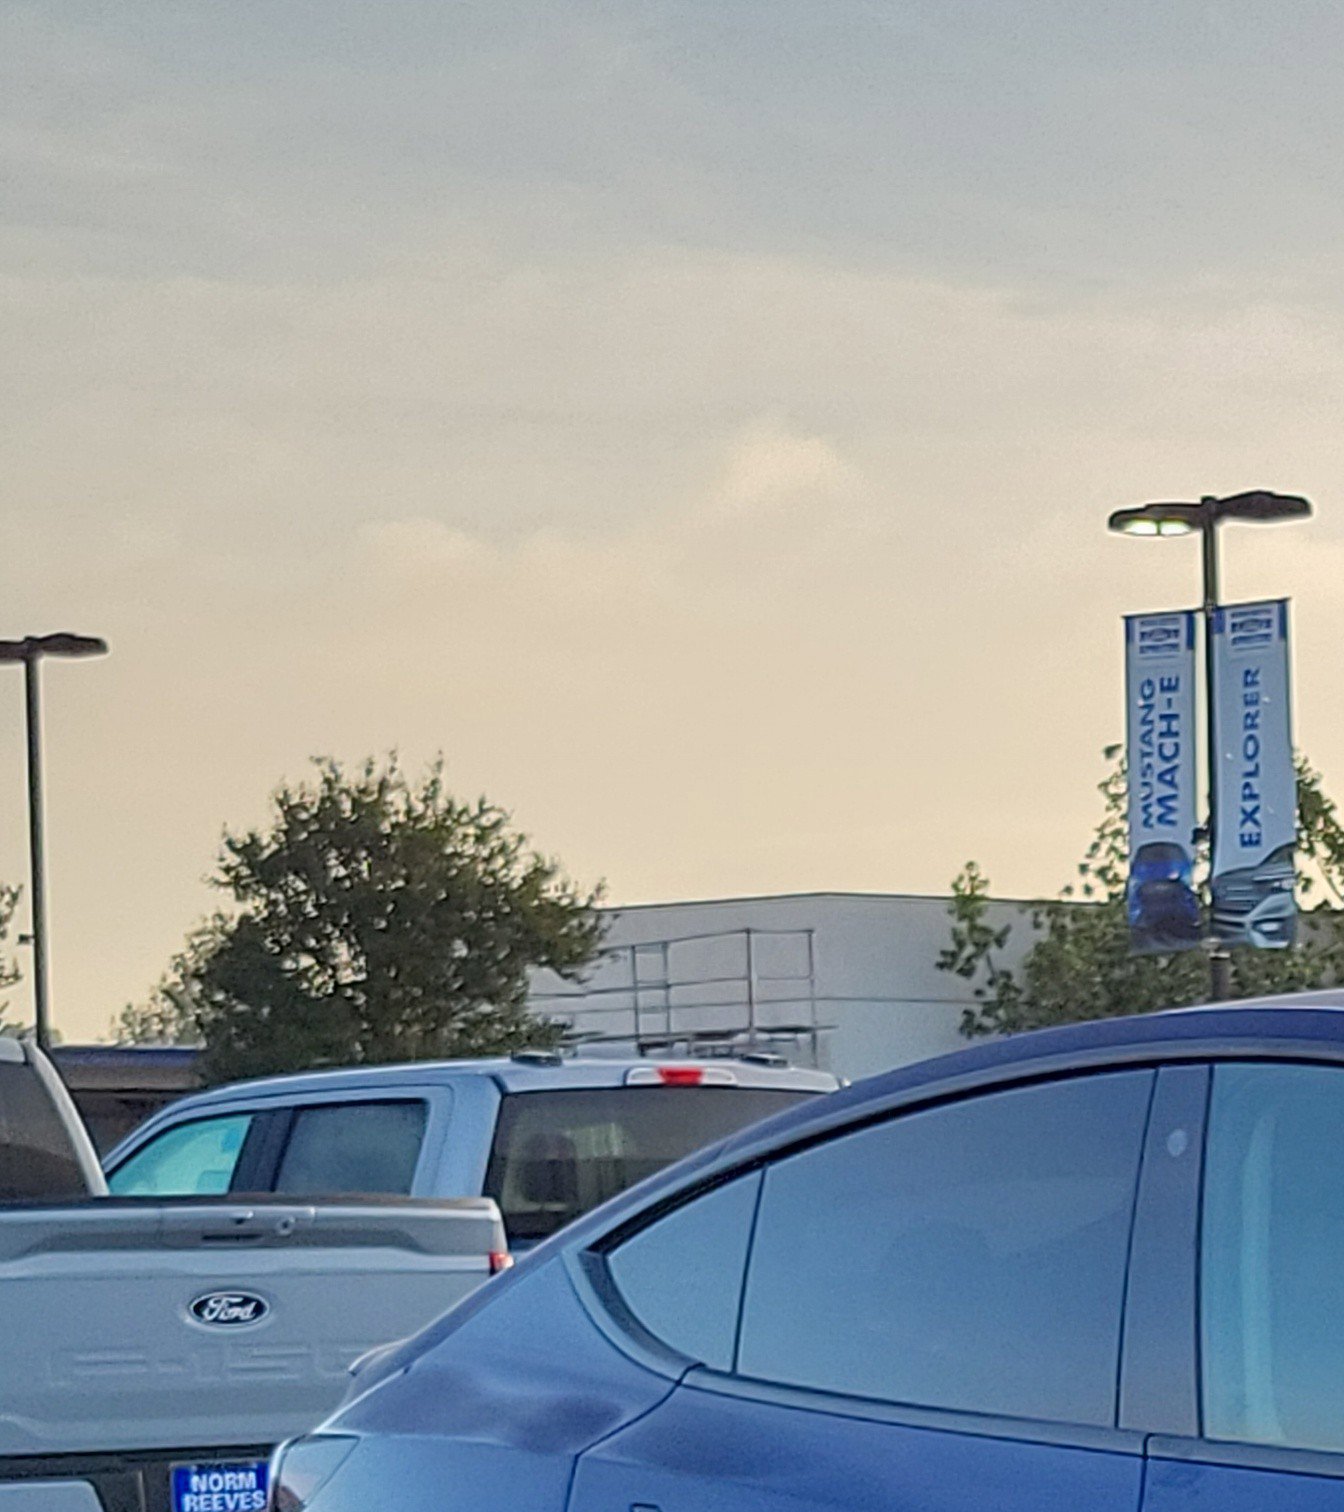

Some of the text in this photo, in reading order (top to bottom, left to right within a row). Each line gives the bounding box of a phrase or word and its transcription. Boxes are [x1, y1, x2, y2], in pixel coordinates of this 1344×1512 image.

[1140, 678, 1157, 829] MUSTANG
[1157, 675, 1181, 827] MACH-E
[1240, 666, 1261, 849] EXPLORER
[202, 1296, 258, 1322] Ford
[190, 1471, 258, 1493] NORM
